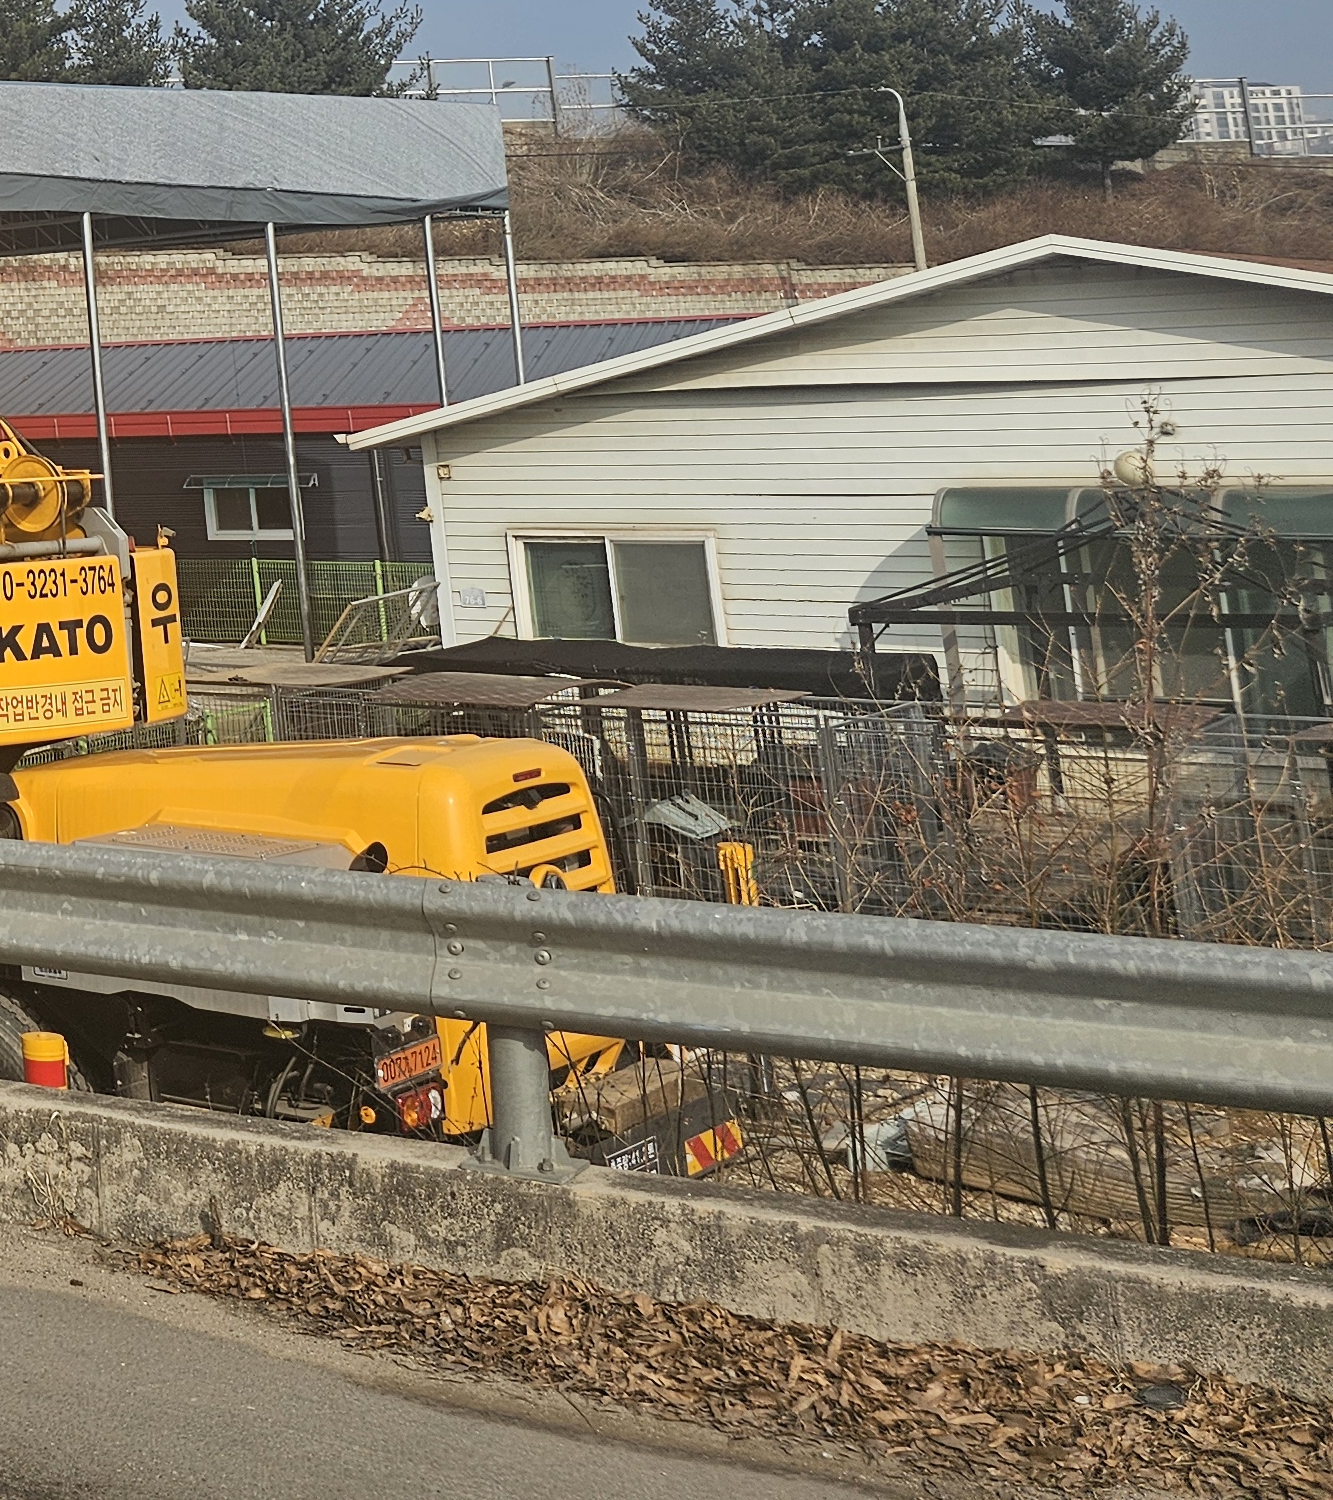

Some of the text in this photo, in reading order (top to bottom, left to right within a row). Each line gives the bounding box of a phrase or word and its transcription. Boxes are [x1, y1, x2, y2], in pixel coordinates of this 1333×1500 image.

[151, 582, 177, 645] 우
[465, 595, 482, 604] 76-6
[72, 688, 96, 717] 접근
[99, 685, 123, 714] 금지
